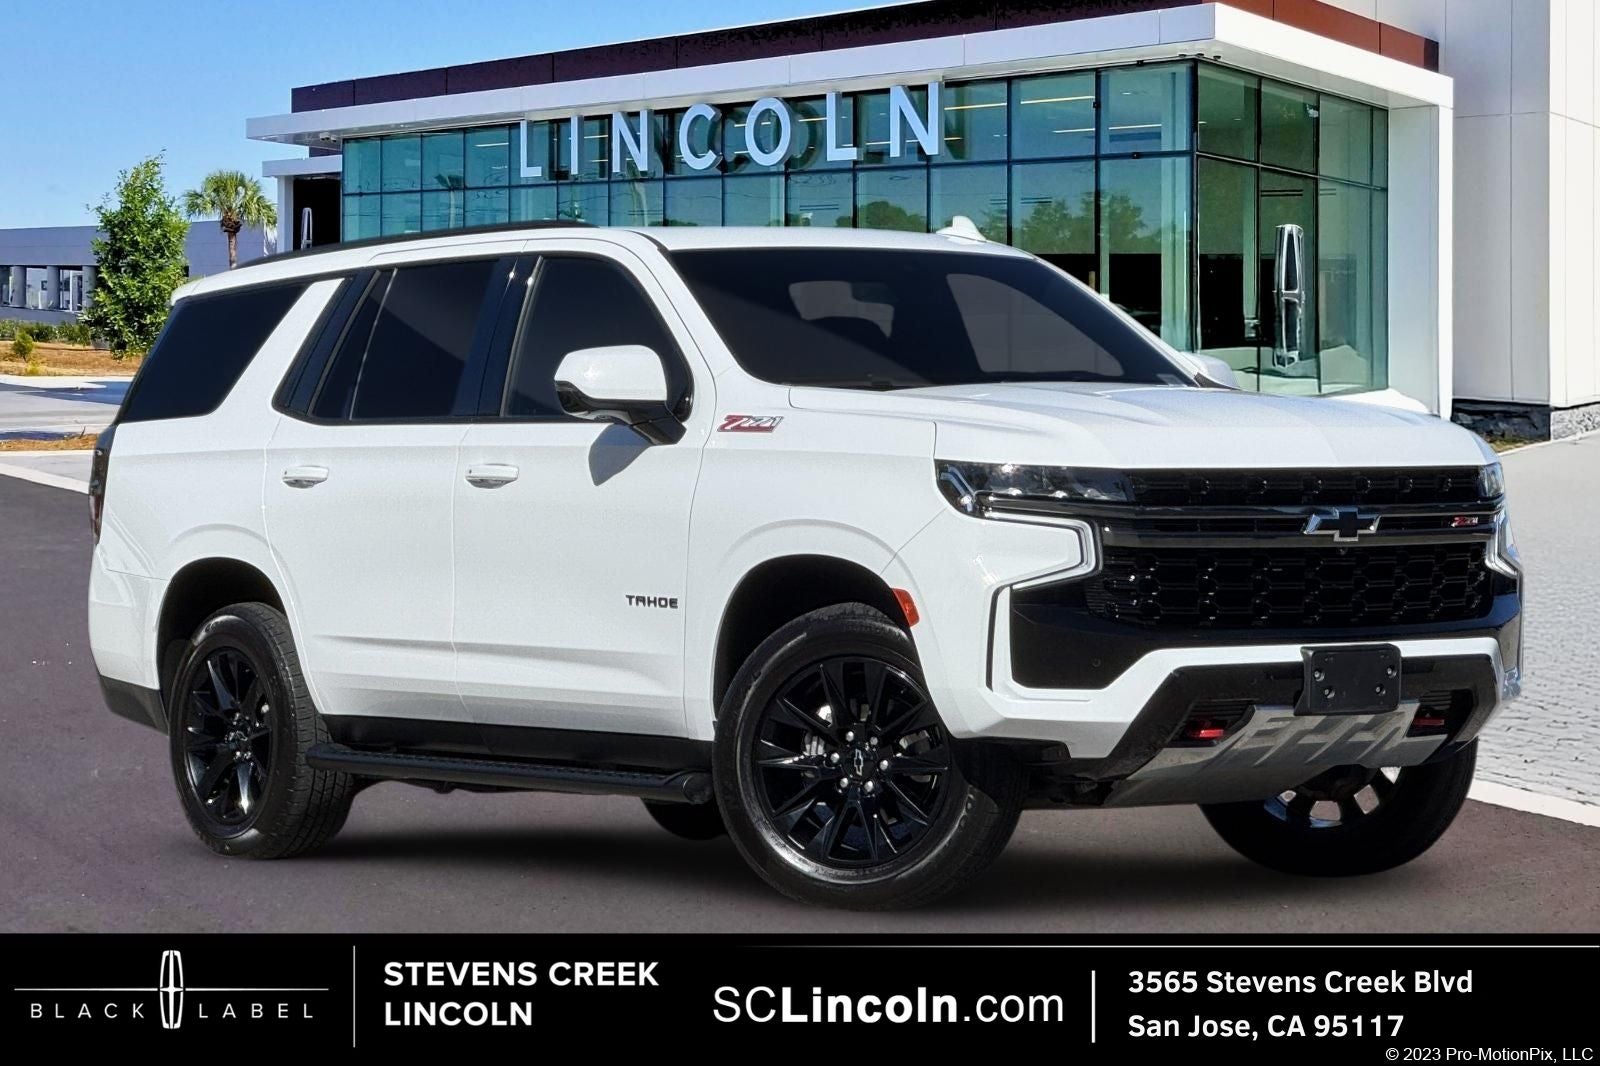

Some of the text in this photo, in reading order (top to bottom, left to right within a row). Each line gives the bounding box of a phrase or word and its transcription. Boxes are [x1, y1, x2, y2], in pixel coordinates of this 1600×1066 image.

[520, 81, 943, 178] LINCOLN
[717, 414, 784, 433] Z71
[625, 594, 678, 609] TAHOE
